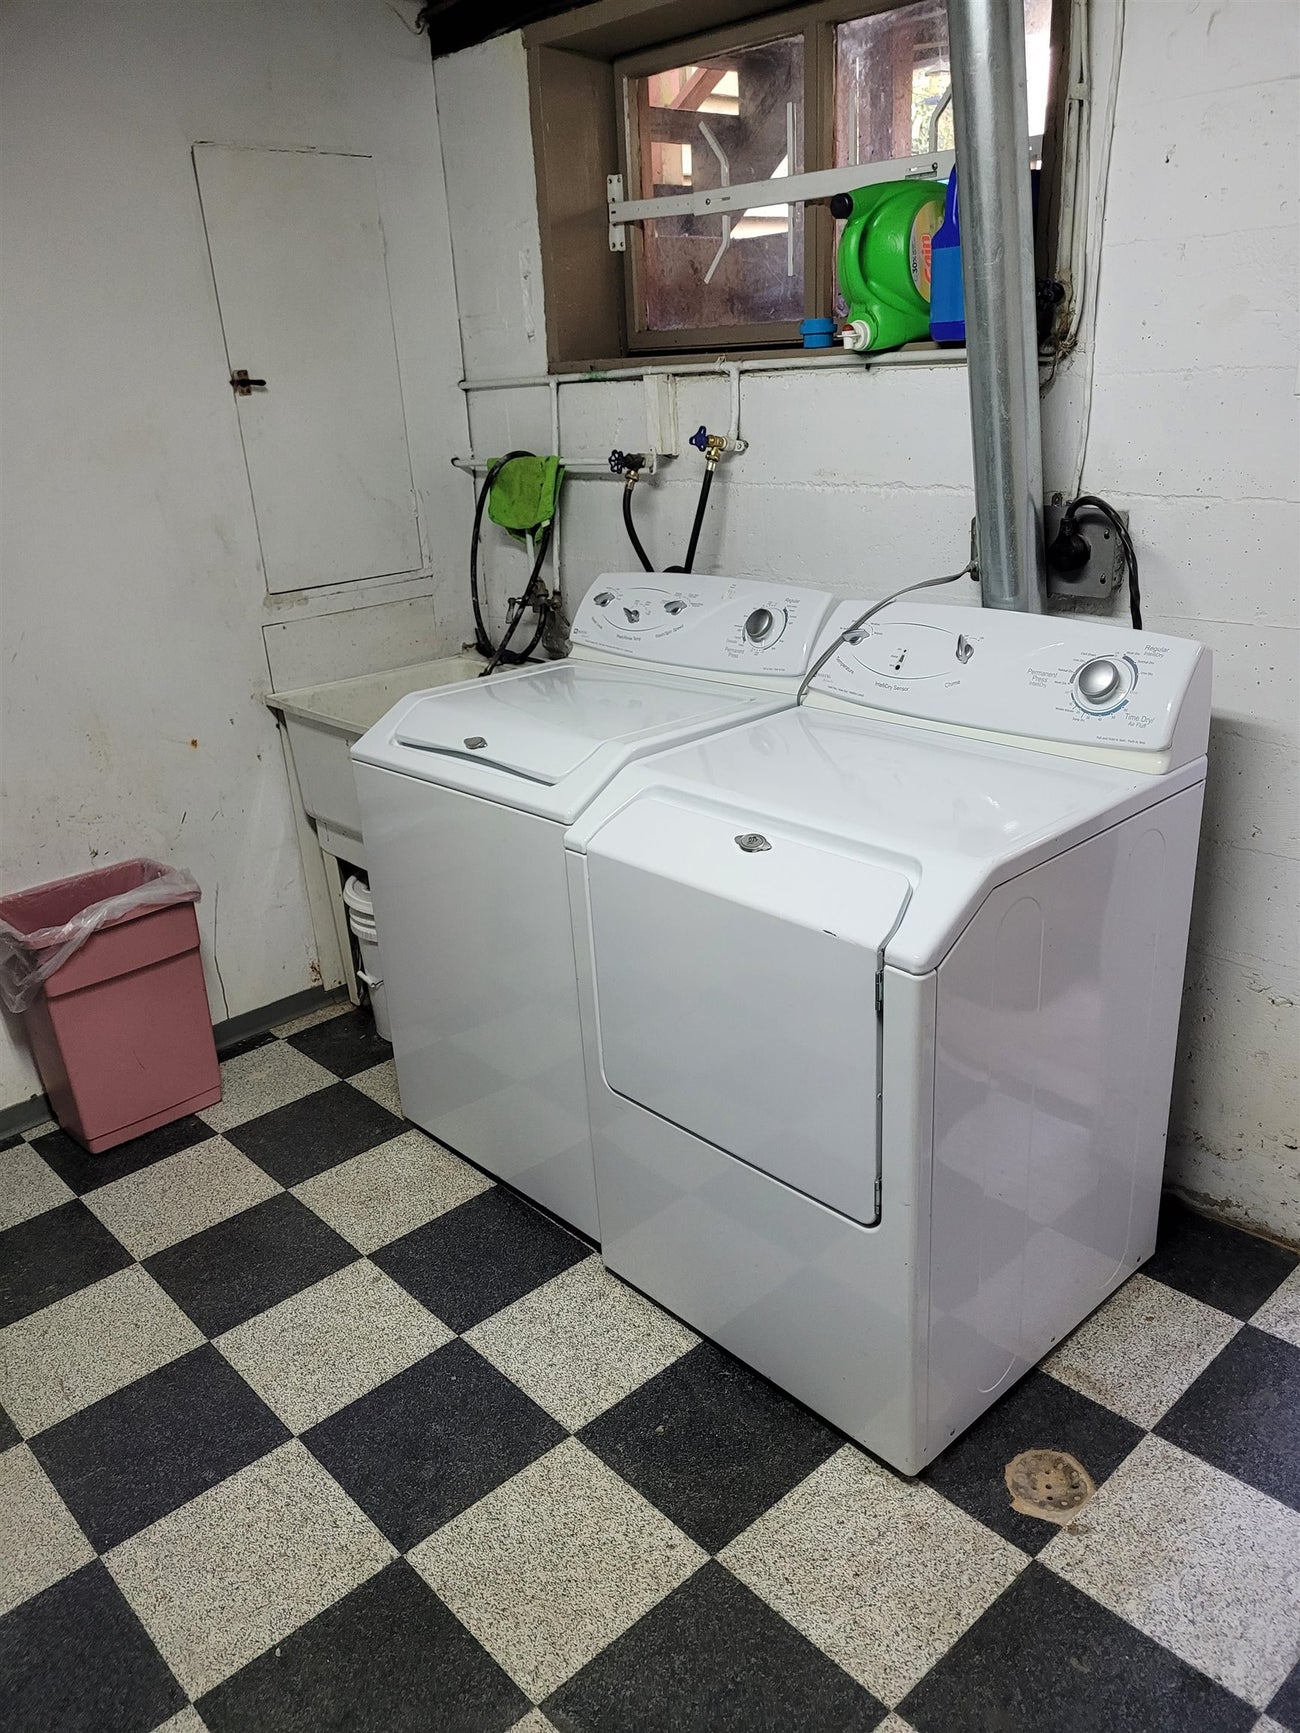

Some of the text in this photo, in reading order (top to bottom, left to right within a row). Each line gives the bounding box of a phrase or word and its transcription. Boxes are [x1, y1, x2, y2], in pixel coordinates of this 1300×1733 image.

[1144, 644, 1170, 653] Regular
[1027, 668, 1058, 679] Permanent
[1031, 675, 1049, 683] Press
[944, 679, 961, 689] Chime
[1125, 713, 1140, 722] Time
[1136, 721, 1147, 729] Fluff
